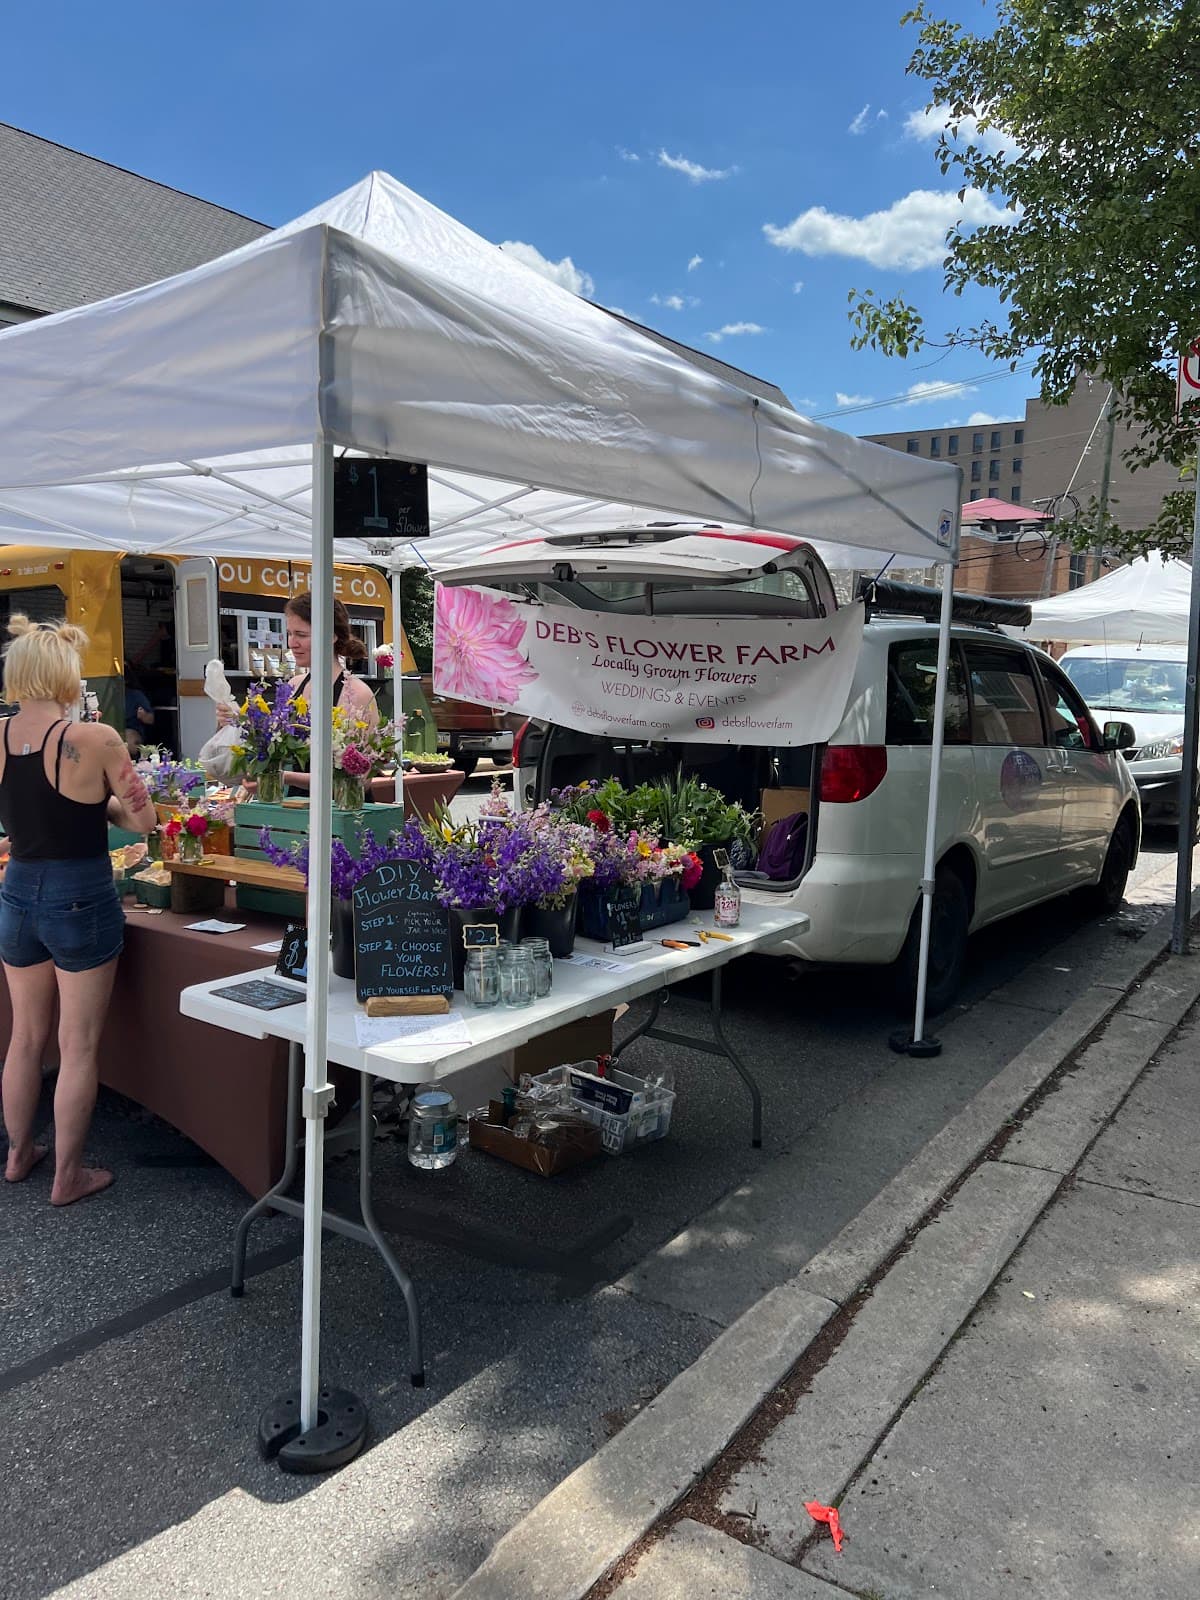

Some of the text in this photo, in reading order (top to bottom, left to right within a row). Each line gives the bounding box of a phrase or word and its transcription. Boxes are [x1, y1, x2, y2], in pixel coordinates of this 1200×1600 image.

[261, 568, 343, 594] COFFE
[350, 579, 381, 599] CO.
[536, 620, 836, 666] DEB'S FLOWER FARM
[591, 655, 757, 685] Locally Grown Flowers
[602, 681, 747, 708] WEDDINGS & EVENTS
[722, 715, 793, 729] debsflowerfarm
[353, 883, 438, 909] Flower Bar
[361, 916, 385, 931] STEP
[359, 942, 382, 954] STEP
[401, 941, 442, 952] CHOOSE
[396, 953, 423, 963] YOUR
[381, 963, 447, 977] FLOWERS!
[360, 986, 383, 996] HELP
[386, 985, 419, 994] YOURSELF
